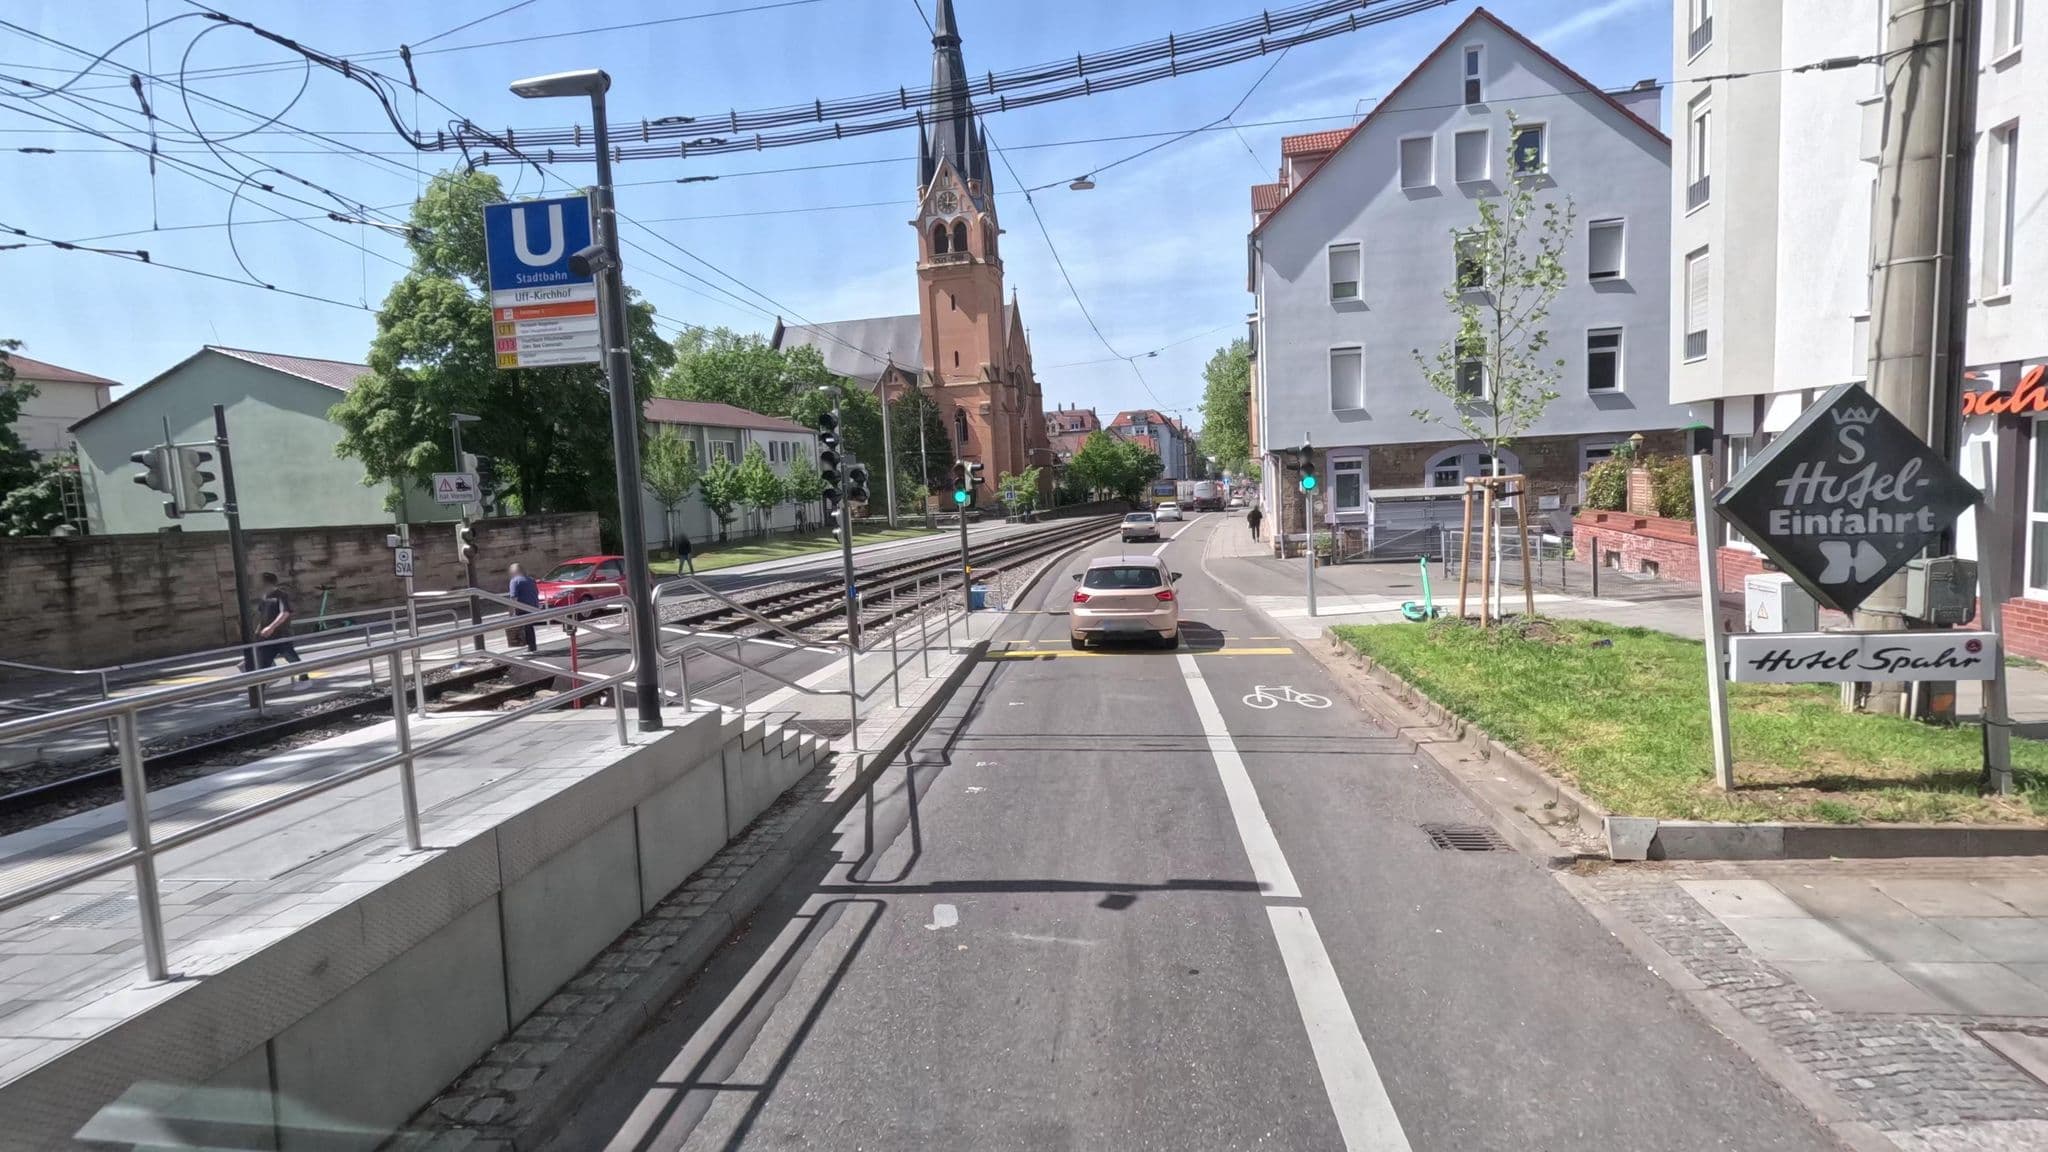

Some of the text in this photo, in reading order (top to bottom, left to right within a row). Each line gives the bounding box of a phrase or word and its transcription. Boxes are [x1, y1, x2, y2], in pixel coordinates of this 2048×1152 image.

[511, 204, 565, 267] U
[516, 271, 568, 285] Stadtbahn
[514, 287, 573, 303] Uff-Kirchhof
[1838, 424, 1866, 465] S
[1775, 456, 1930, 509] Hotel-
[1769, 505, 1936, 536] Einfahrt
[396, 562, 413, 573] SVA
[1748, 647, 1982, 674] Hotel Spahr
